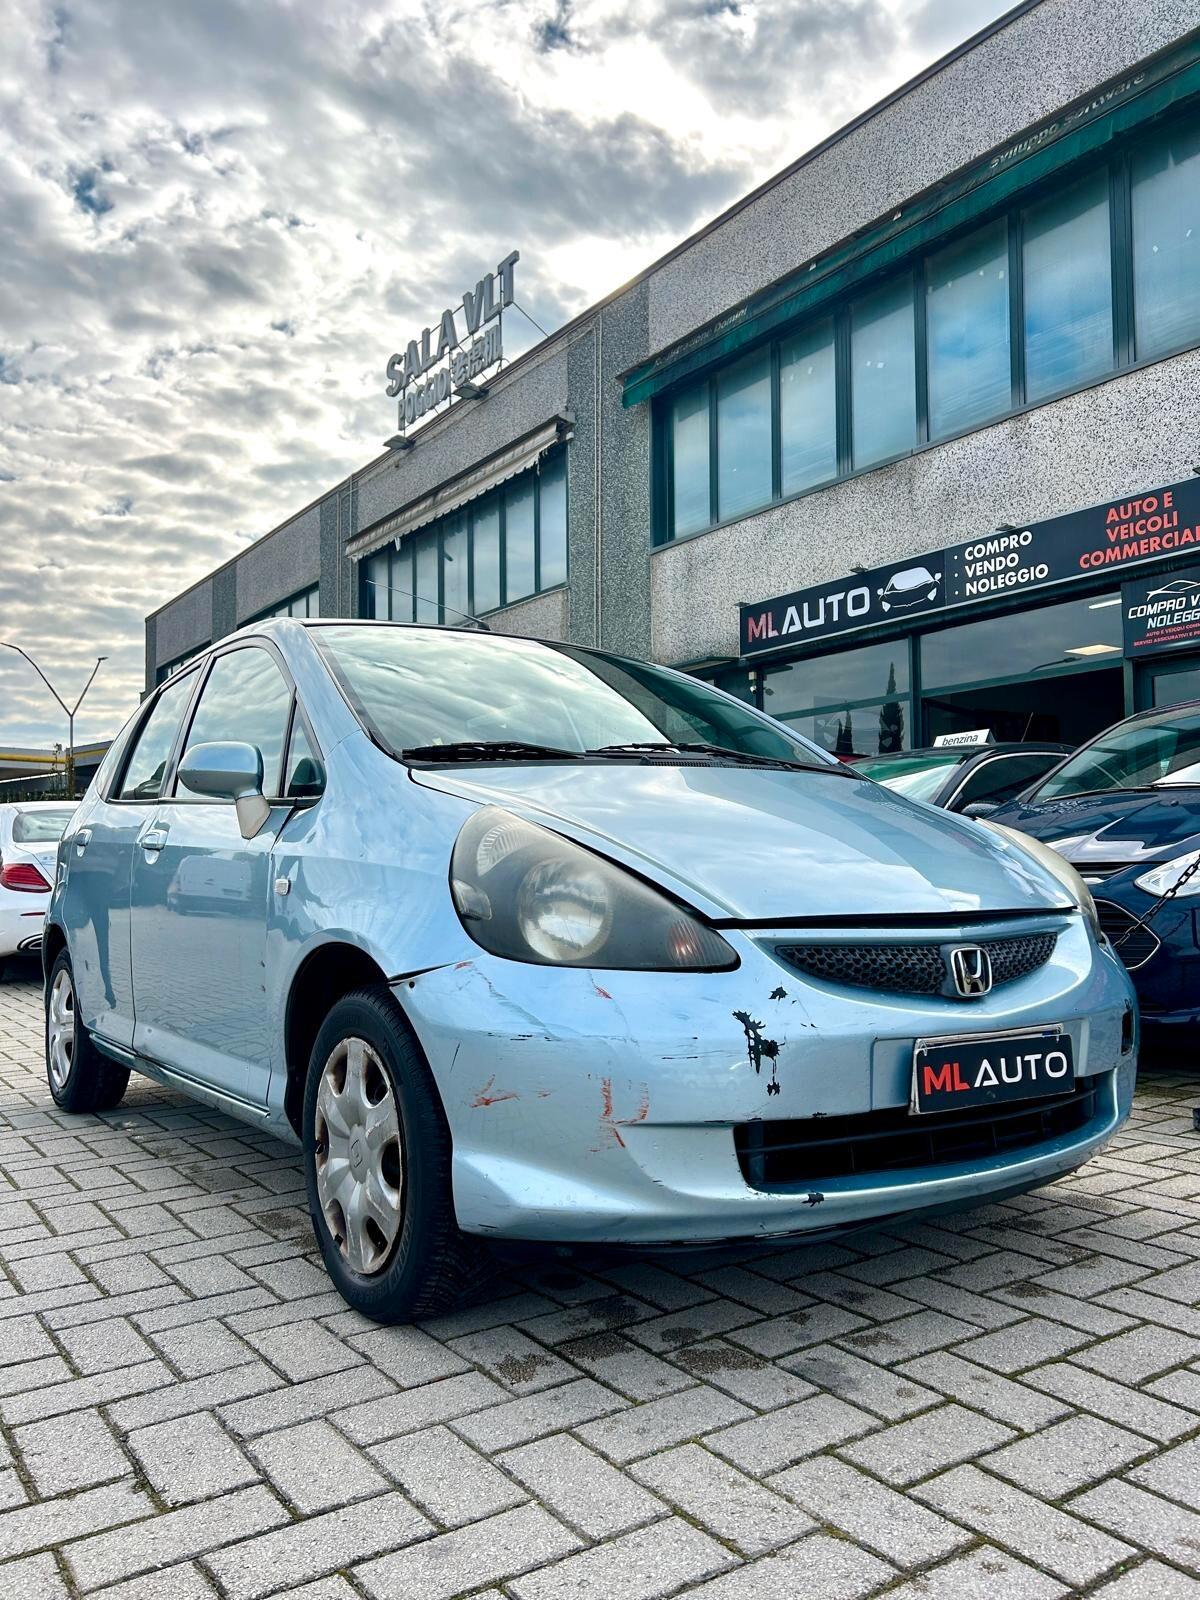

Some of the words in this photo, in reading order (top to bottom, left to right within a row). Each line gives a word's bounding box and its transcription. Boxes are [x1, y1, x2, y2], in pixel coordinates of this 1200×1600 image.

[989, 123, 1059, 169] Sviluppo
[386, 309, 459, 397] SALA
[463, 250, 520, 335] VLT
[398, 367, 451, 431] POGGIO
[1106, 496, 1158, 524] AUTO
[1163, 491, 1173, 508] E
[1106, 511, 1178, 542] VEICOLI
[964, 531, 1033, 561] COMPRO
[964, 553, 1020, 578] VENDO
[965, 564, 1049, 596] NOLEGGIO
[748, 606, 779, 643] ML
[781, 586, 871, 635] AUTO
[1128, 597, 1187, 619] COMPRO
[941, 733, 979, 746] benzina
[923, 1062, 971, 1095] ML
[973, 1051, 1068, 1088] AUTO
